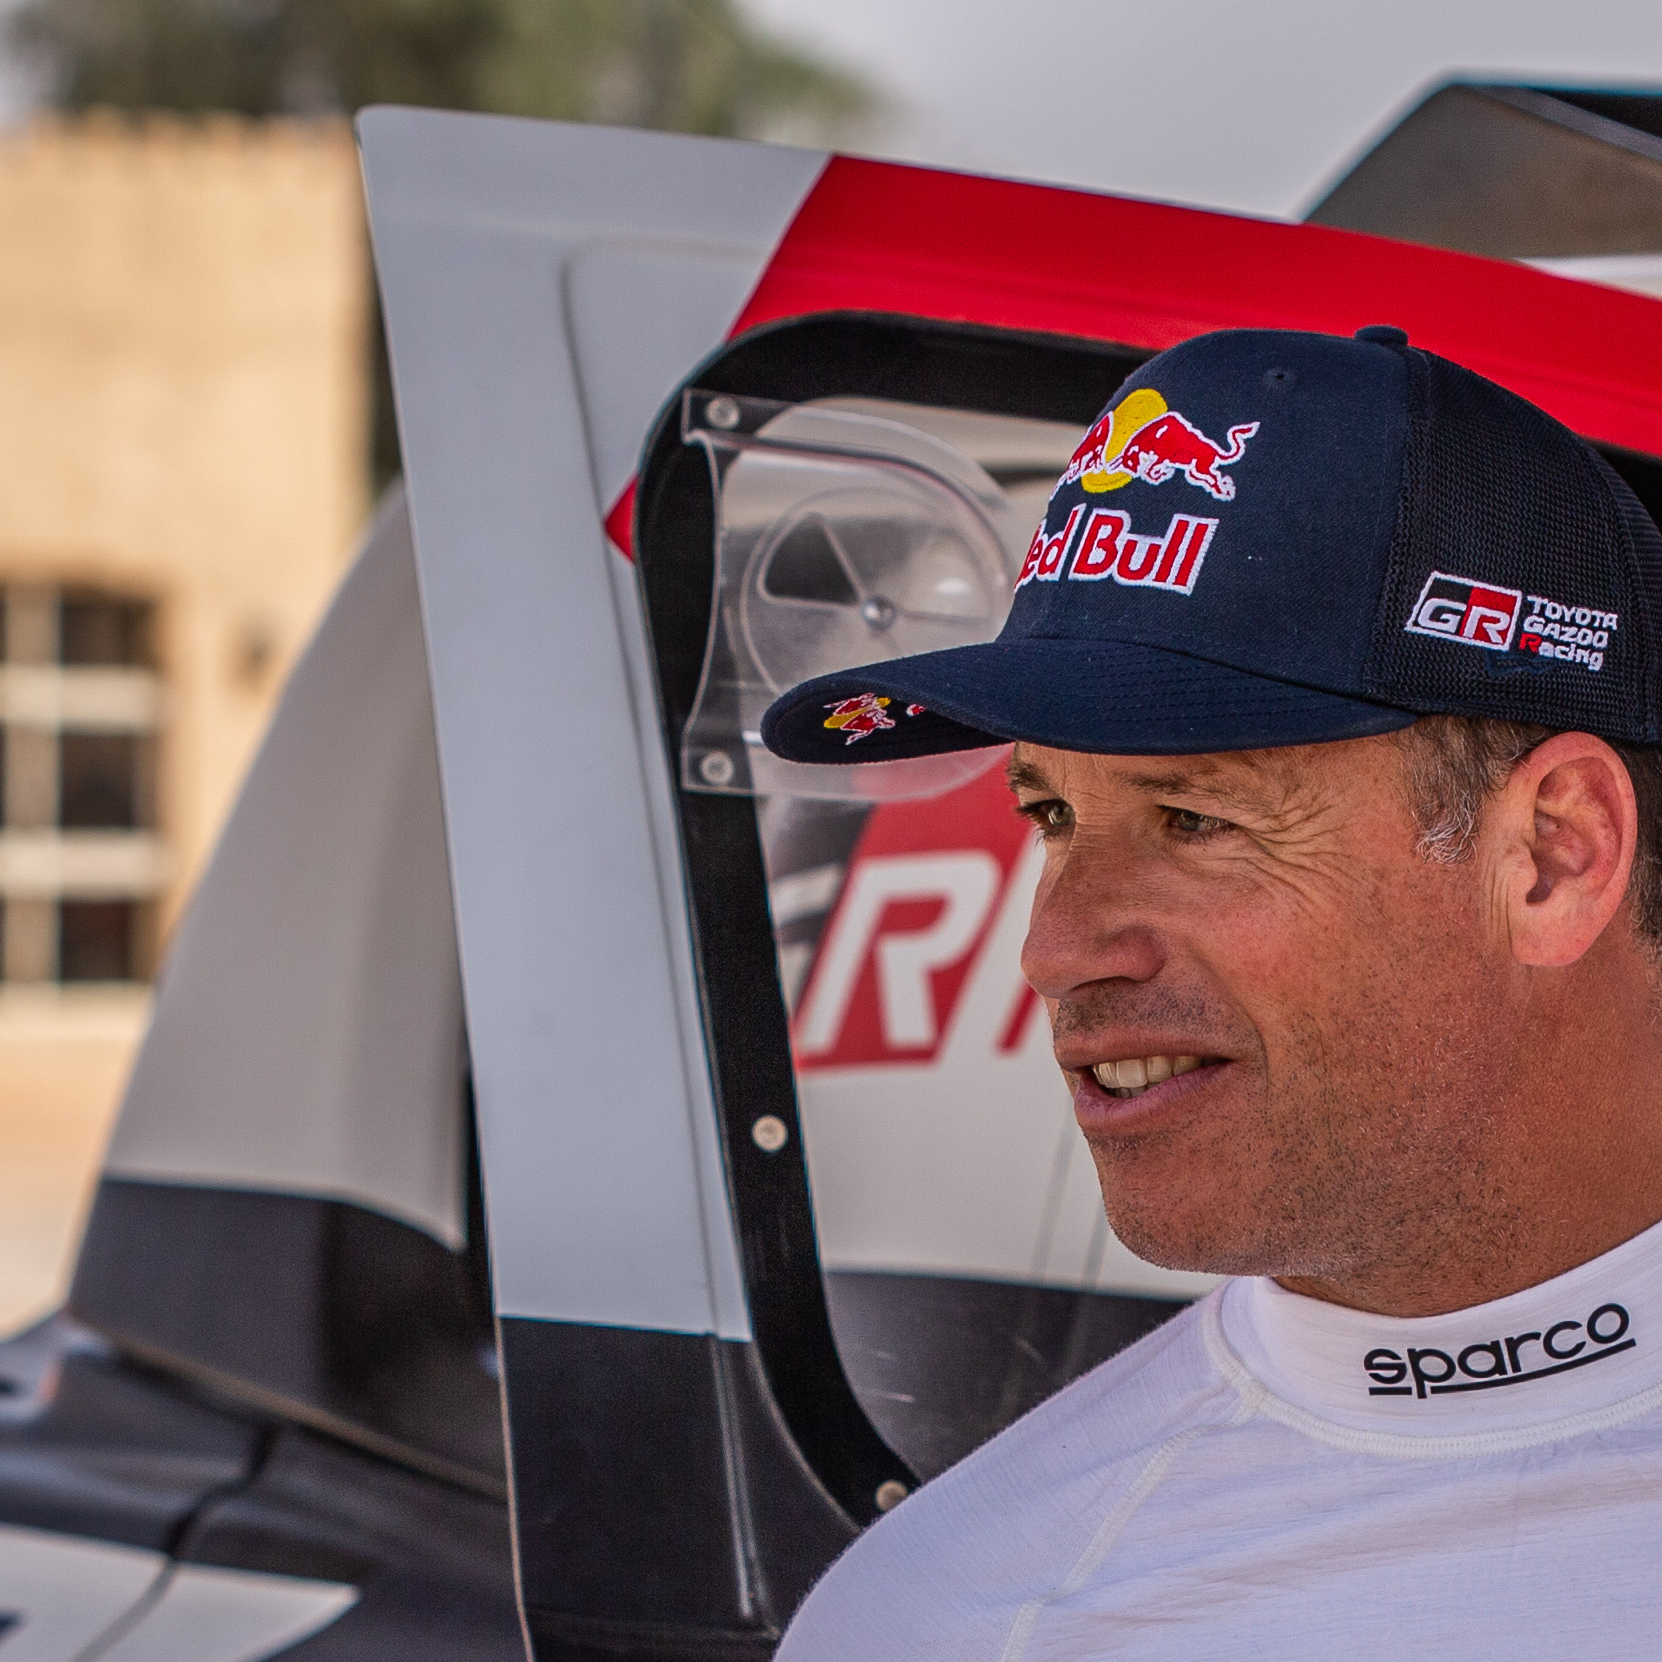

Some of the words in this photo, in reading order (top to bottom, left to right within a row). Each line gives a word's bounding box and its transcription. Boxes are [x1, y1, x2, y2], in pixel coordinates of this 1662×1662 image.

[1014, 503, 1086, 594] ed
[1068, 507, 1219, 596] Bull
[1414, 594, 1514, 647] GR
[1522, 614, 1609, 650] GAZOO
[1526, 594, 1618, 631] TOYOTA
[1519, 633, 1604, 672] Racing
[1363, 1303, 1637, 1399] sparco
